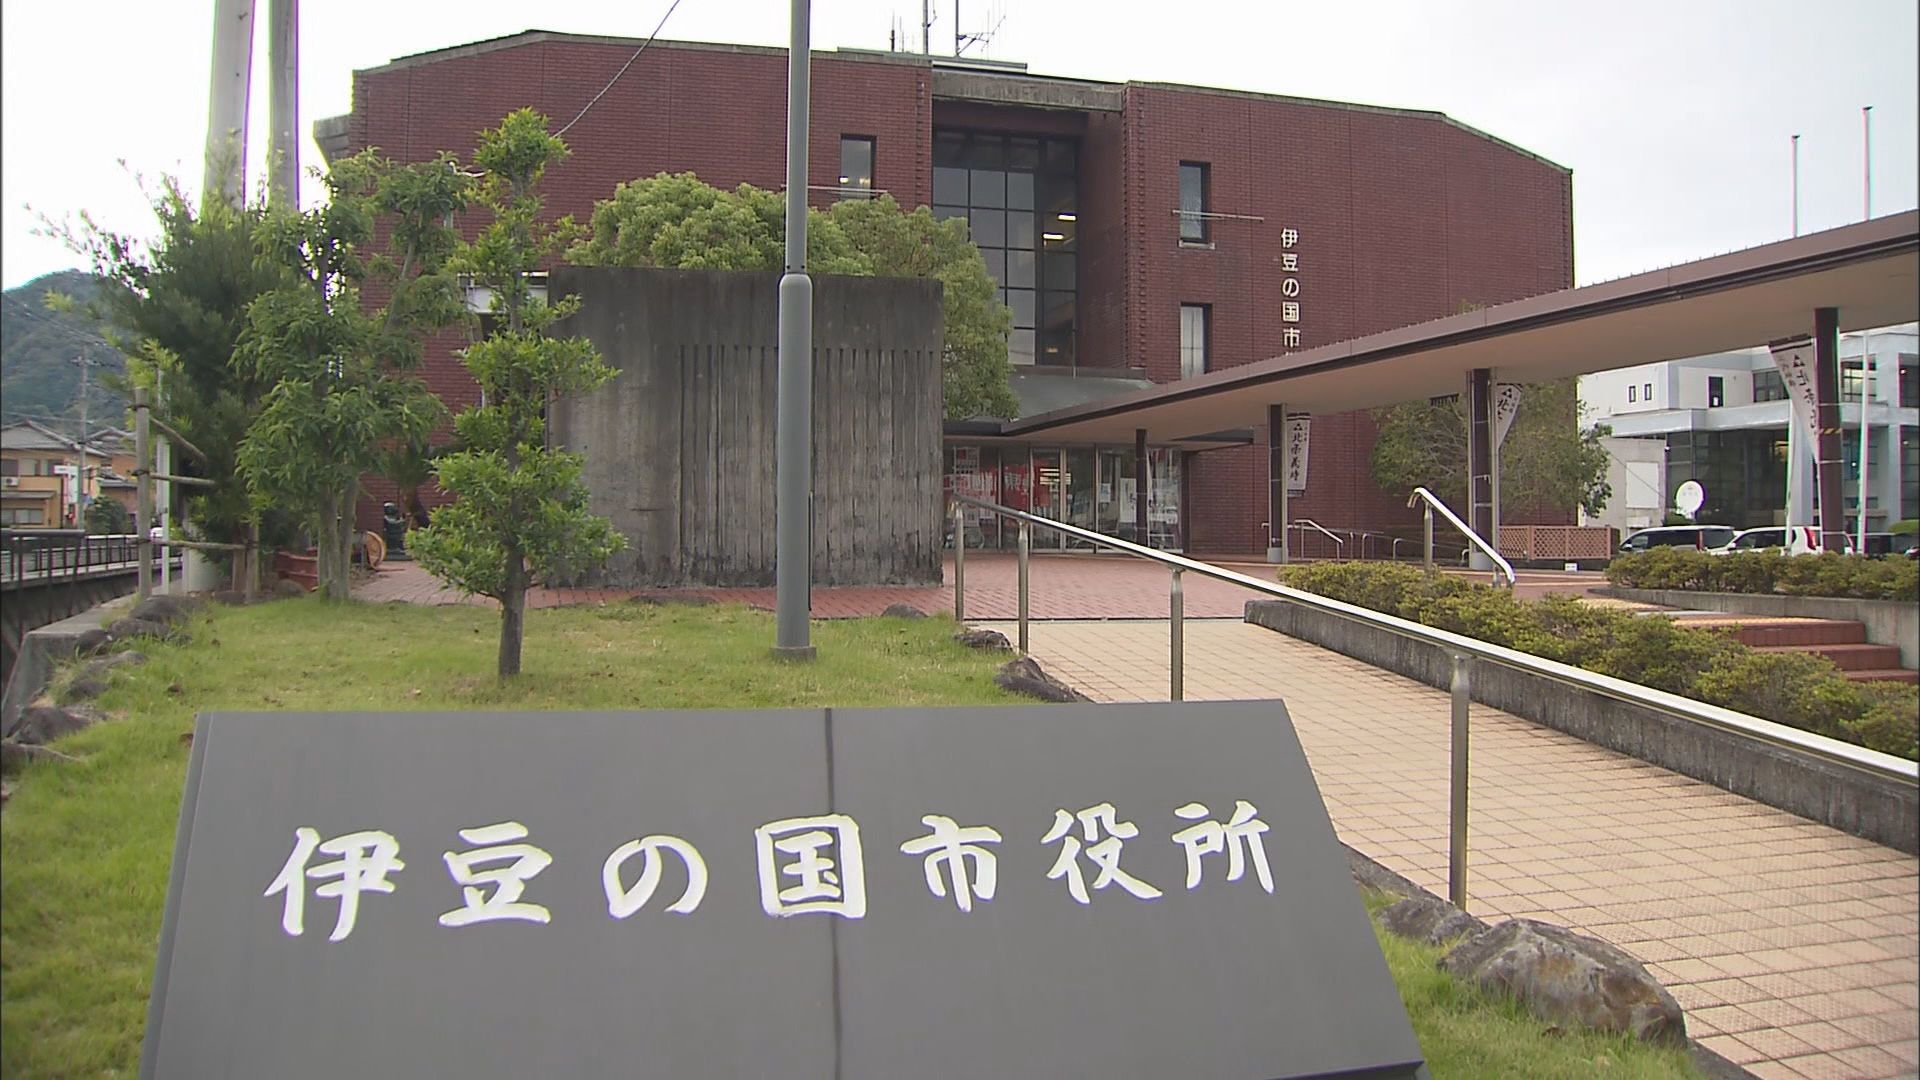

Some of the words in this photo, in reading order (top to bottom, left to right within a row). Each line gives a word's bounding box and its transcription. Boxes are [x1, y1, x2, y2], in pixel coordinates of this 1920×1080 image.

[1280, 227, 1301, 355] 伊豆の国市
[264, 800, 1275, 941] 伊豆の国市役所
